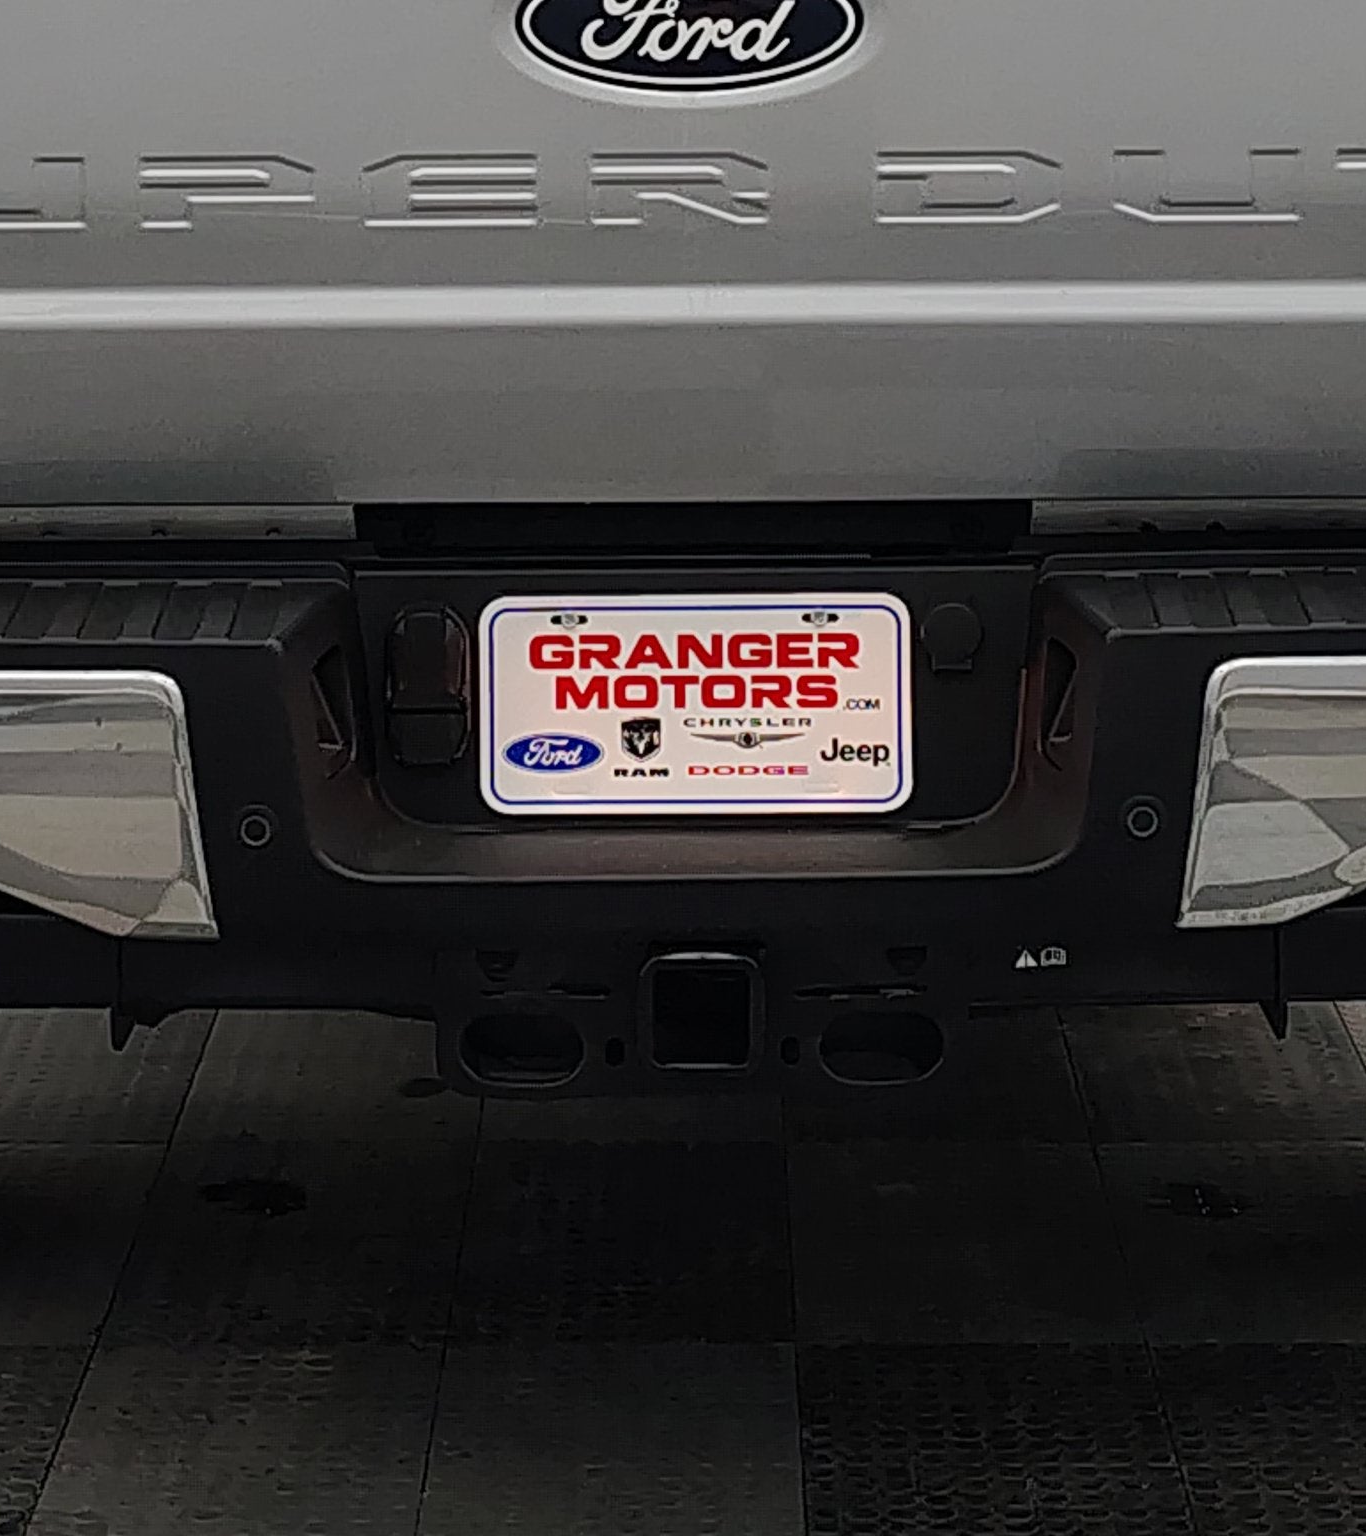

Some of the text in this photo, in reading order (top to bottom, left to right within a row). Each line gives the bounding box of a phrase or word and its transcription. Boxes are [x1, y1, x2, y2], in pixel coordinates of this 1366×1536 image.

[528, 633, 860, 670] GRANGER
[554, 674, 838, 710] MOTORS
[683, 717, 812, 728] CHRYSLER
[523, 739, 582, 767] Ford
[820, 737, 891, 767] Jeep
[613, 767, 670, 777] RAM
[688, 765, 809, 775] DODGE
